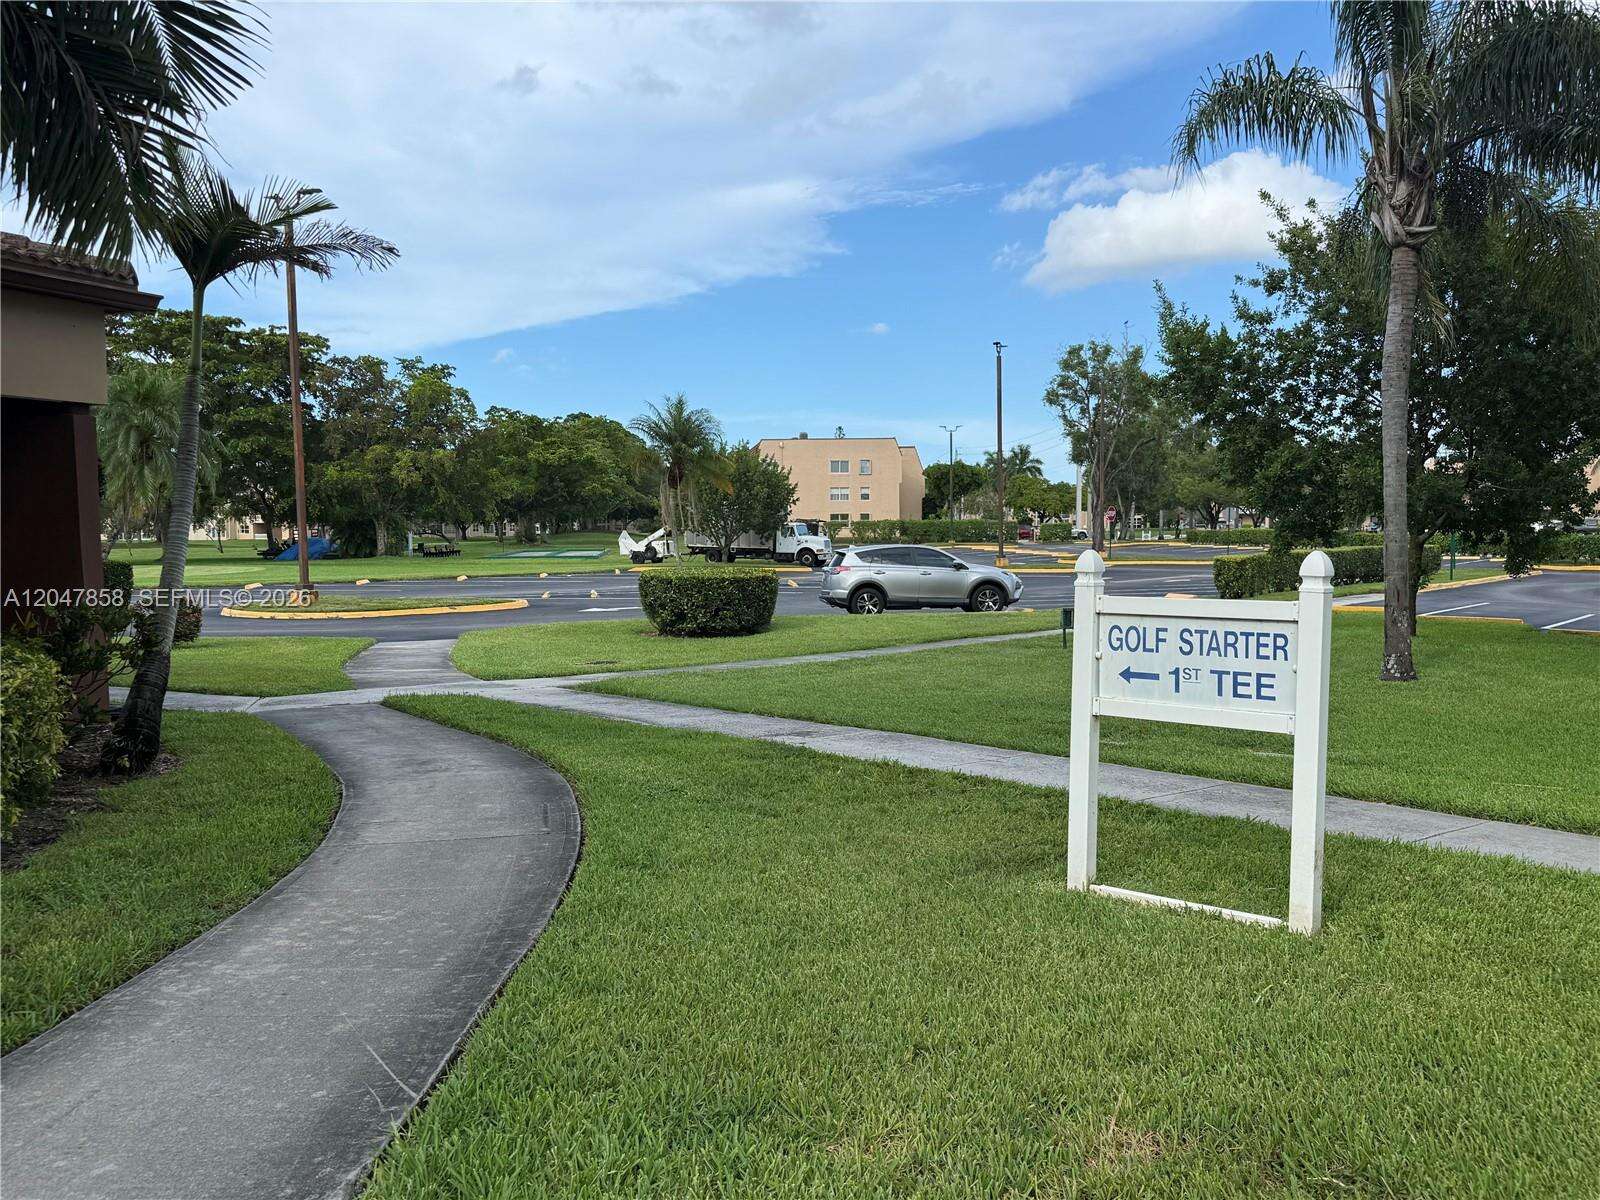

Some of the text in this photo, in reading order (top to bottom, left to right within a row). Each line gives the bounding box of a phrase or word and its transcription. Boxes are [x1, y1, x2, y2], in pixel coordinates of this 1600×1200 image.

[1108, 624, 1289, 662] GOLF STARTER
[1168, 667, 1277, 702] 1ST TEE
